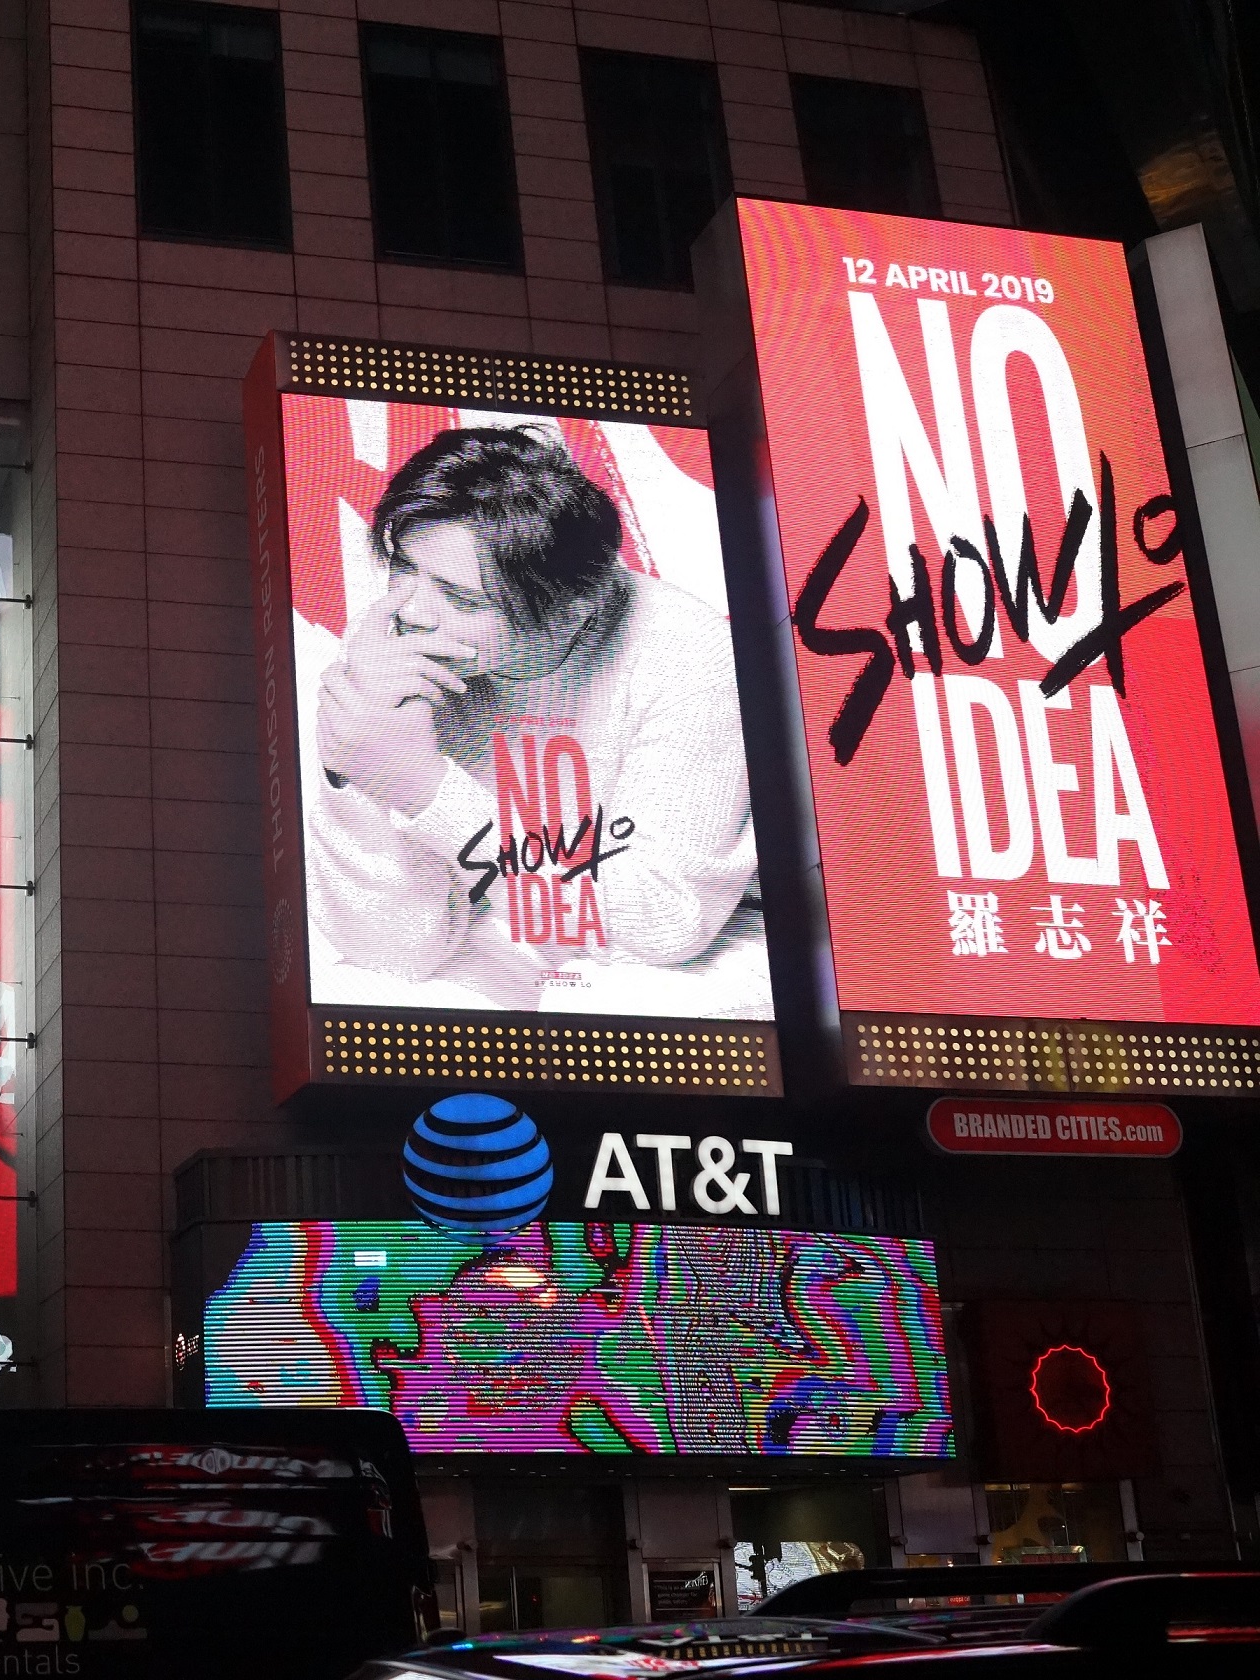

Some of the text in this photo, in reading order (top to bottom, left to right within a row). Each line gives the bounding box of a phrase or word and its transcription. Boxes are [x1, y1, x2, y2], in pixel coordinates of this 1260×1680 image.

[842, 257, 1055, 304] 12 APRIL 2019
[847, 290, 1104, 668] NO
[255, 445, 284, 874] THOMSON REUTERS
[493, 732, 595, 869] NO
[912, 672, 1171, 890] IDEA
[506, 872, 608, 948] IDEA
[947, 890, 1173, 965] 羅志祥
[953, 1113, 1164, 1142] BRANDED CITIES.com
[584, 1132, 793, 1216] AT&T
[71, 1556, 145, 1591] inc.
